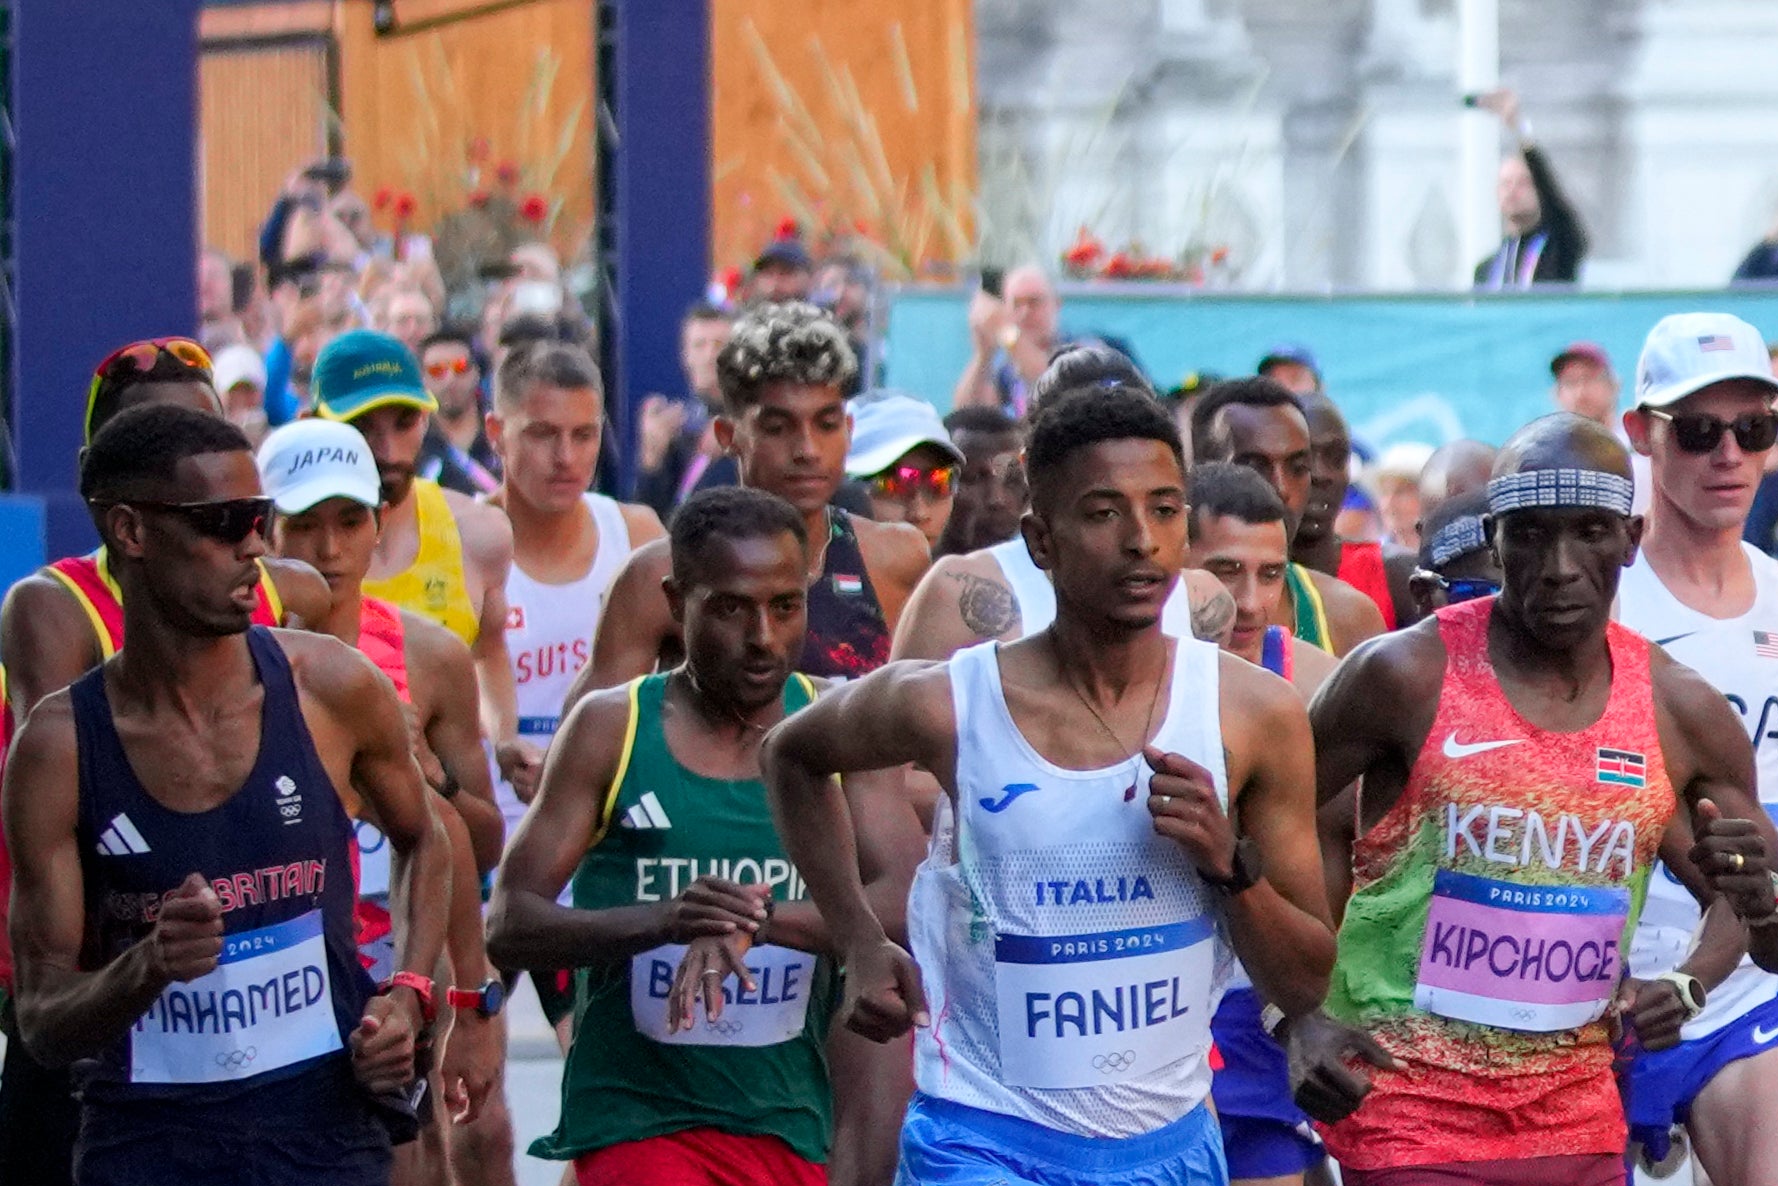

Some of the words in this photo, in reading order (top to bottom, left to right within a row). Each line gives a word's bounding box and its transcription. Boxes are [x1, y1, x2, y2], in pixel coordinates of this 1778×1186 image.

[287, 447, 359, 475] JAPAN
[1446, 802, 1636, 876] KENYA
[211, 858, 327, 912] BRITAIN
[1036, 876, 1156, 907] ITALIA
[1490, 887, 1541, 907] PARIS
[1546, 891, 1590, 908] 2024
[228, 934, 275, 956] 2024
[1051, 939, 1109, 958] PARIS
[1115, 933, 1165, 952] 2024
[1025, 976, 1190, 1039] FANIEL
